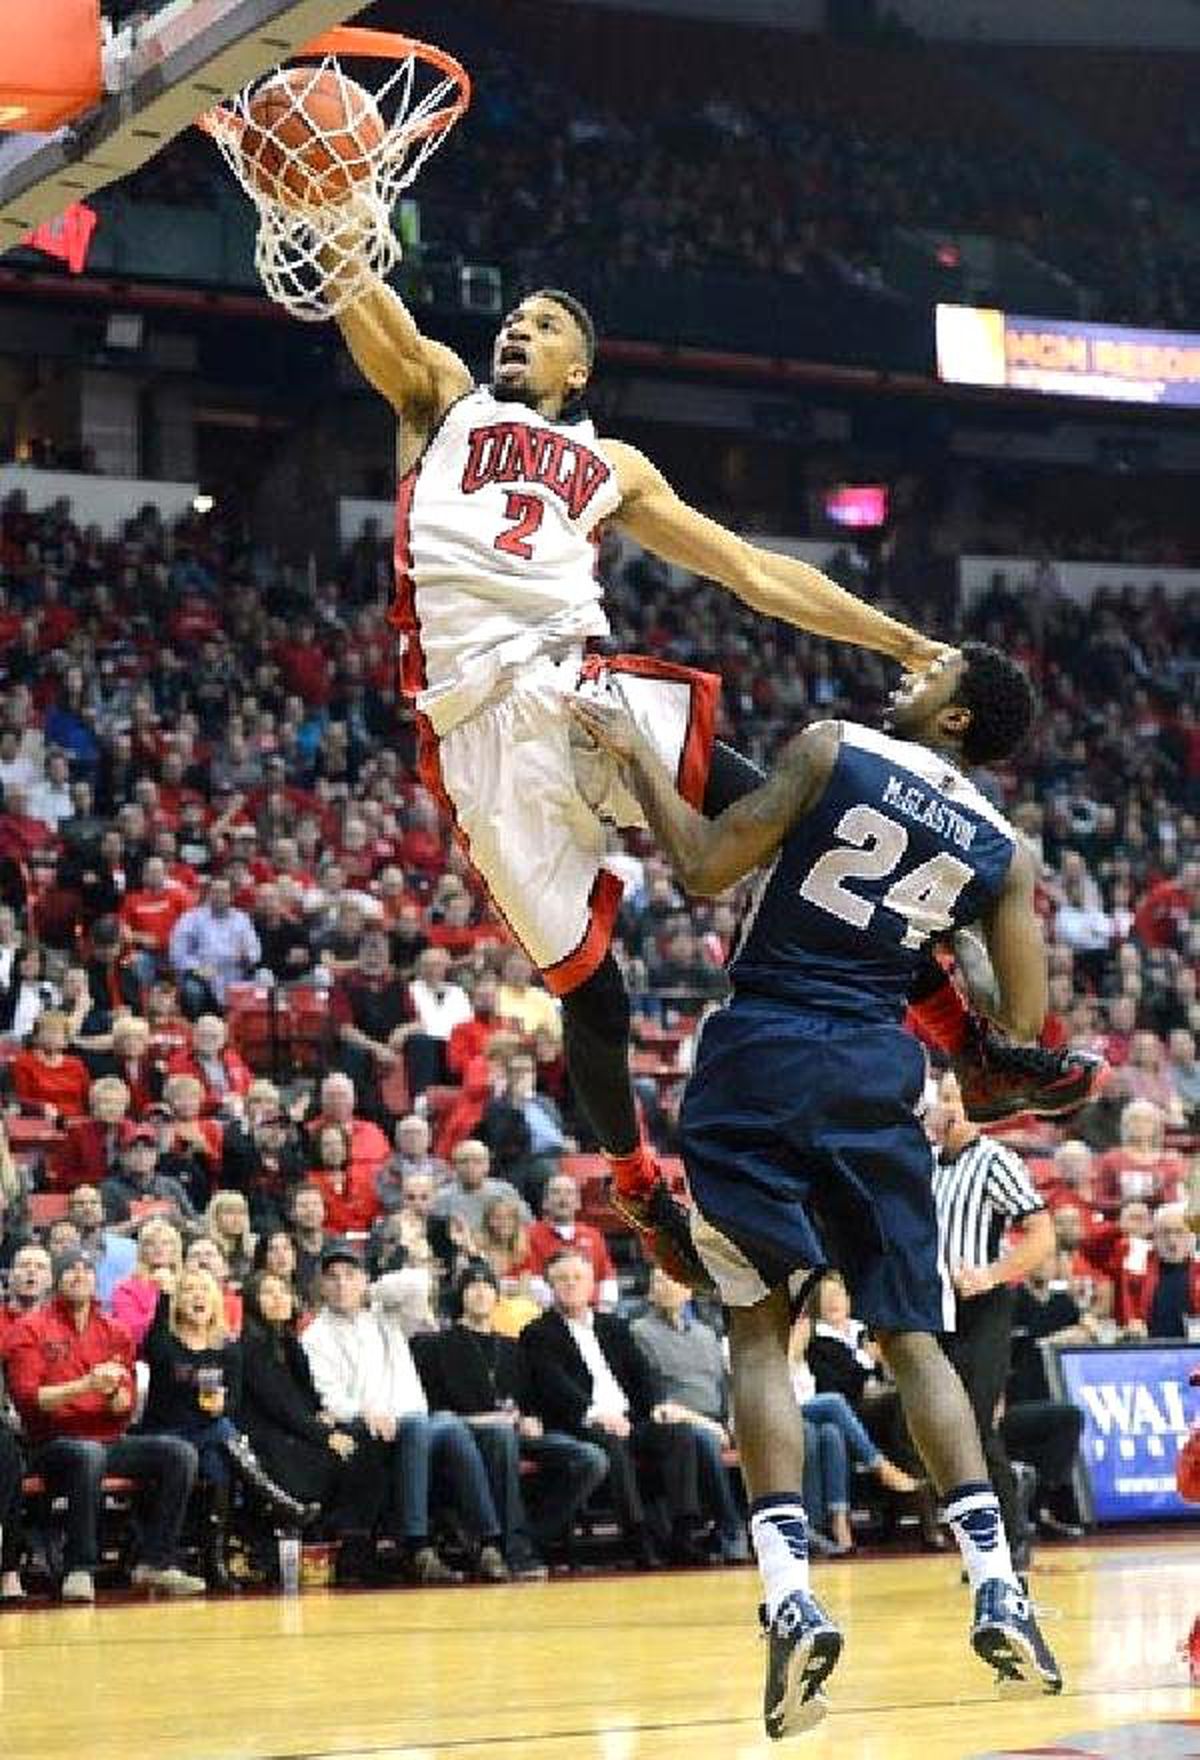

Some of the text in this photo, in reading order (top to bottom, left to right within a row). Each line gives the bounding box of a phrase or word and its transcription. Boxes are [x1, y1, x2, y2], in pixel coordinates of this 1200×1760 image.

[462, 422, 611, 520] UNLV
[493, 492, 545, 560] 2
[799, 803, 976, 950] 24
